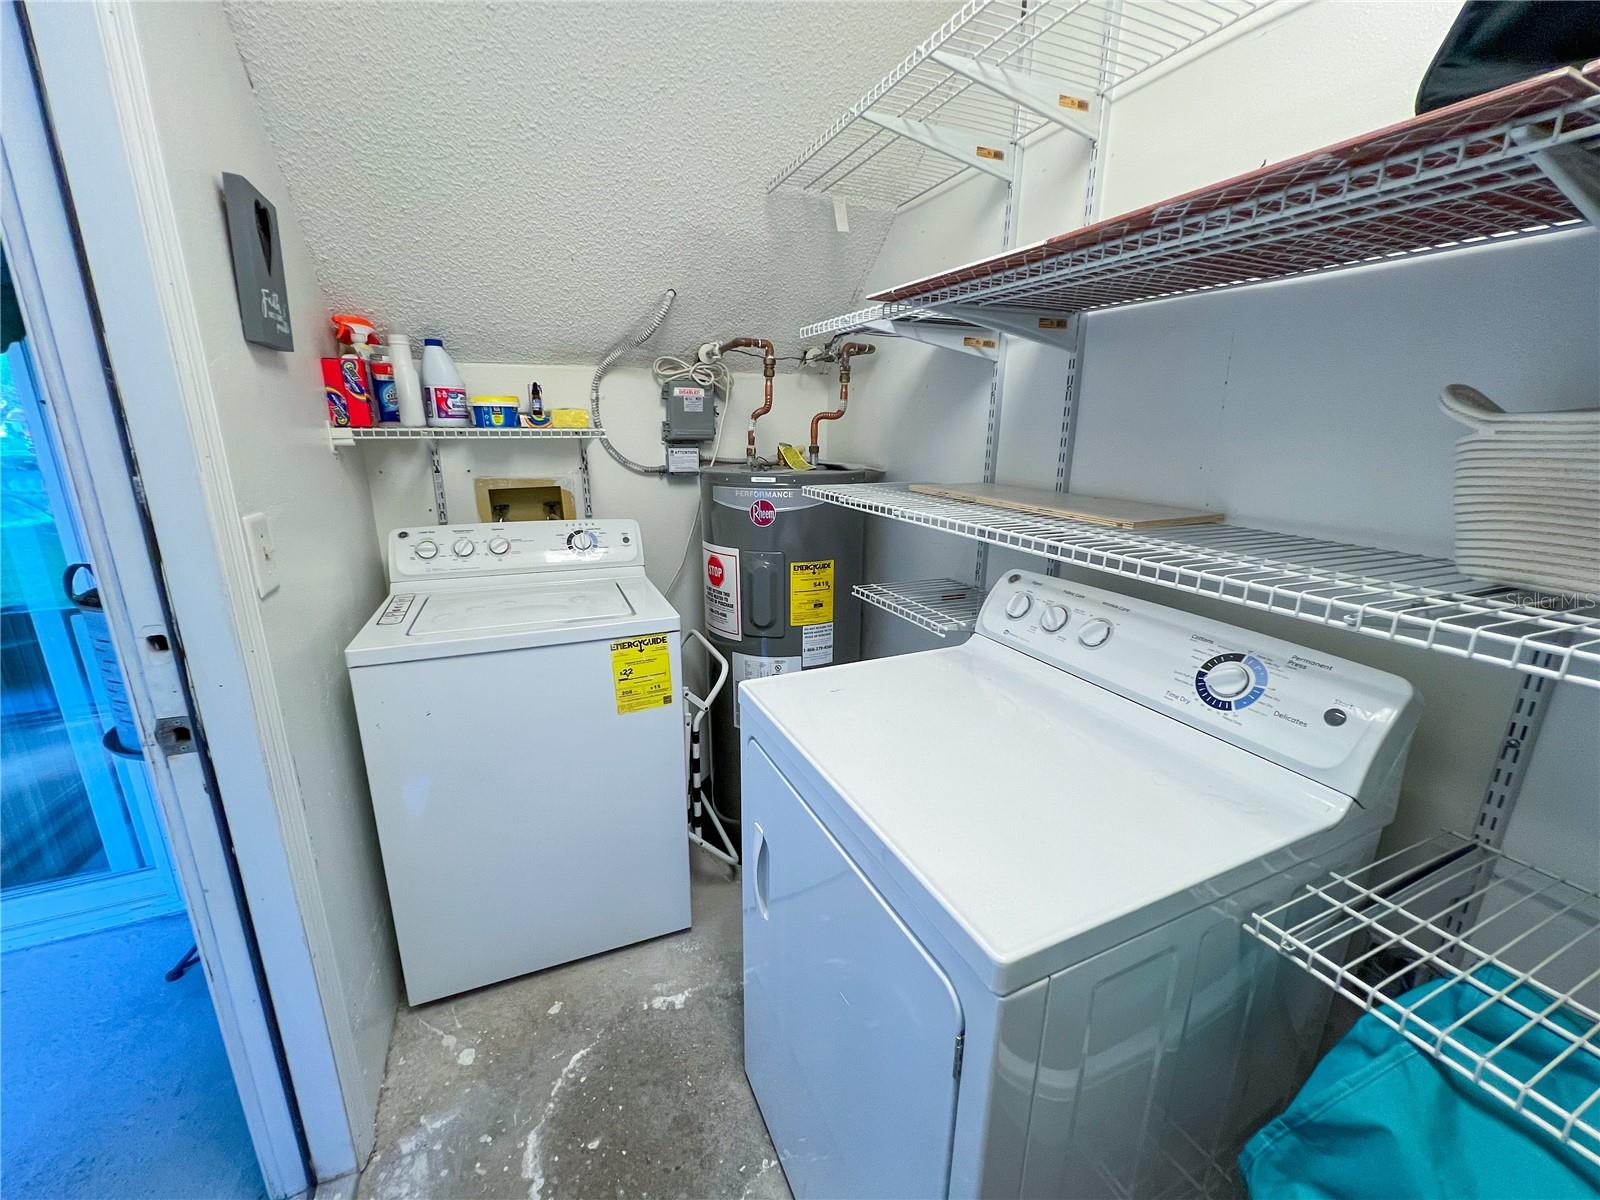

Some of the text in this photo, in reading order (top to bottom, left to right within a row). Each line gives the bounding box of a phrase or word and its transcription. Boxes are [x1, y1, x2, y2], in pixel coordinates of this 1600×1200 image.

[735, 490, 793, 498] PERFORMANCE
[752, 500, 775, 522] Rheem
[708, 564, 723, 578] STOP
[793, 562, 832, 572] ENERGYGUIDE
[610, 636, 668, 651] ENERGYGUIDE
[1287, 660, 1308, 670] Press
[1291, 655, 1335, 671] Permanent
[1334, 698, 1354, 709] Start
[1273, 710, 1308, 728] Delicates
